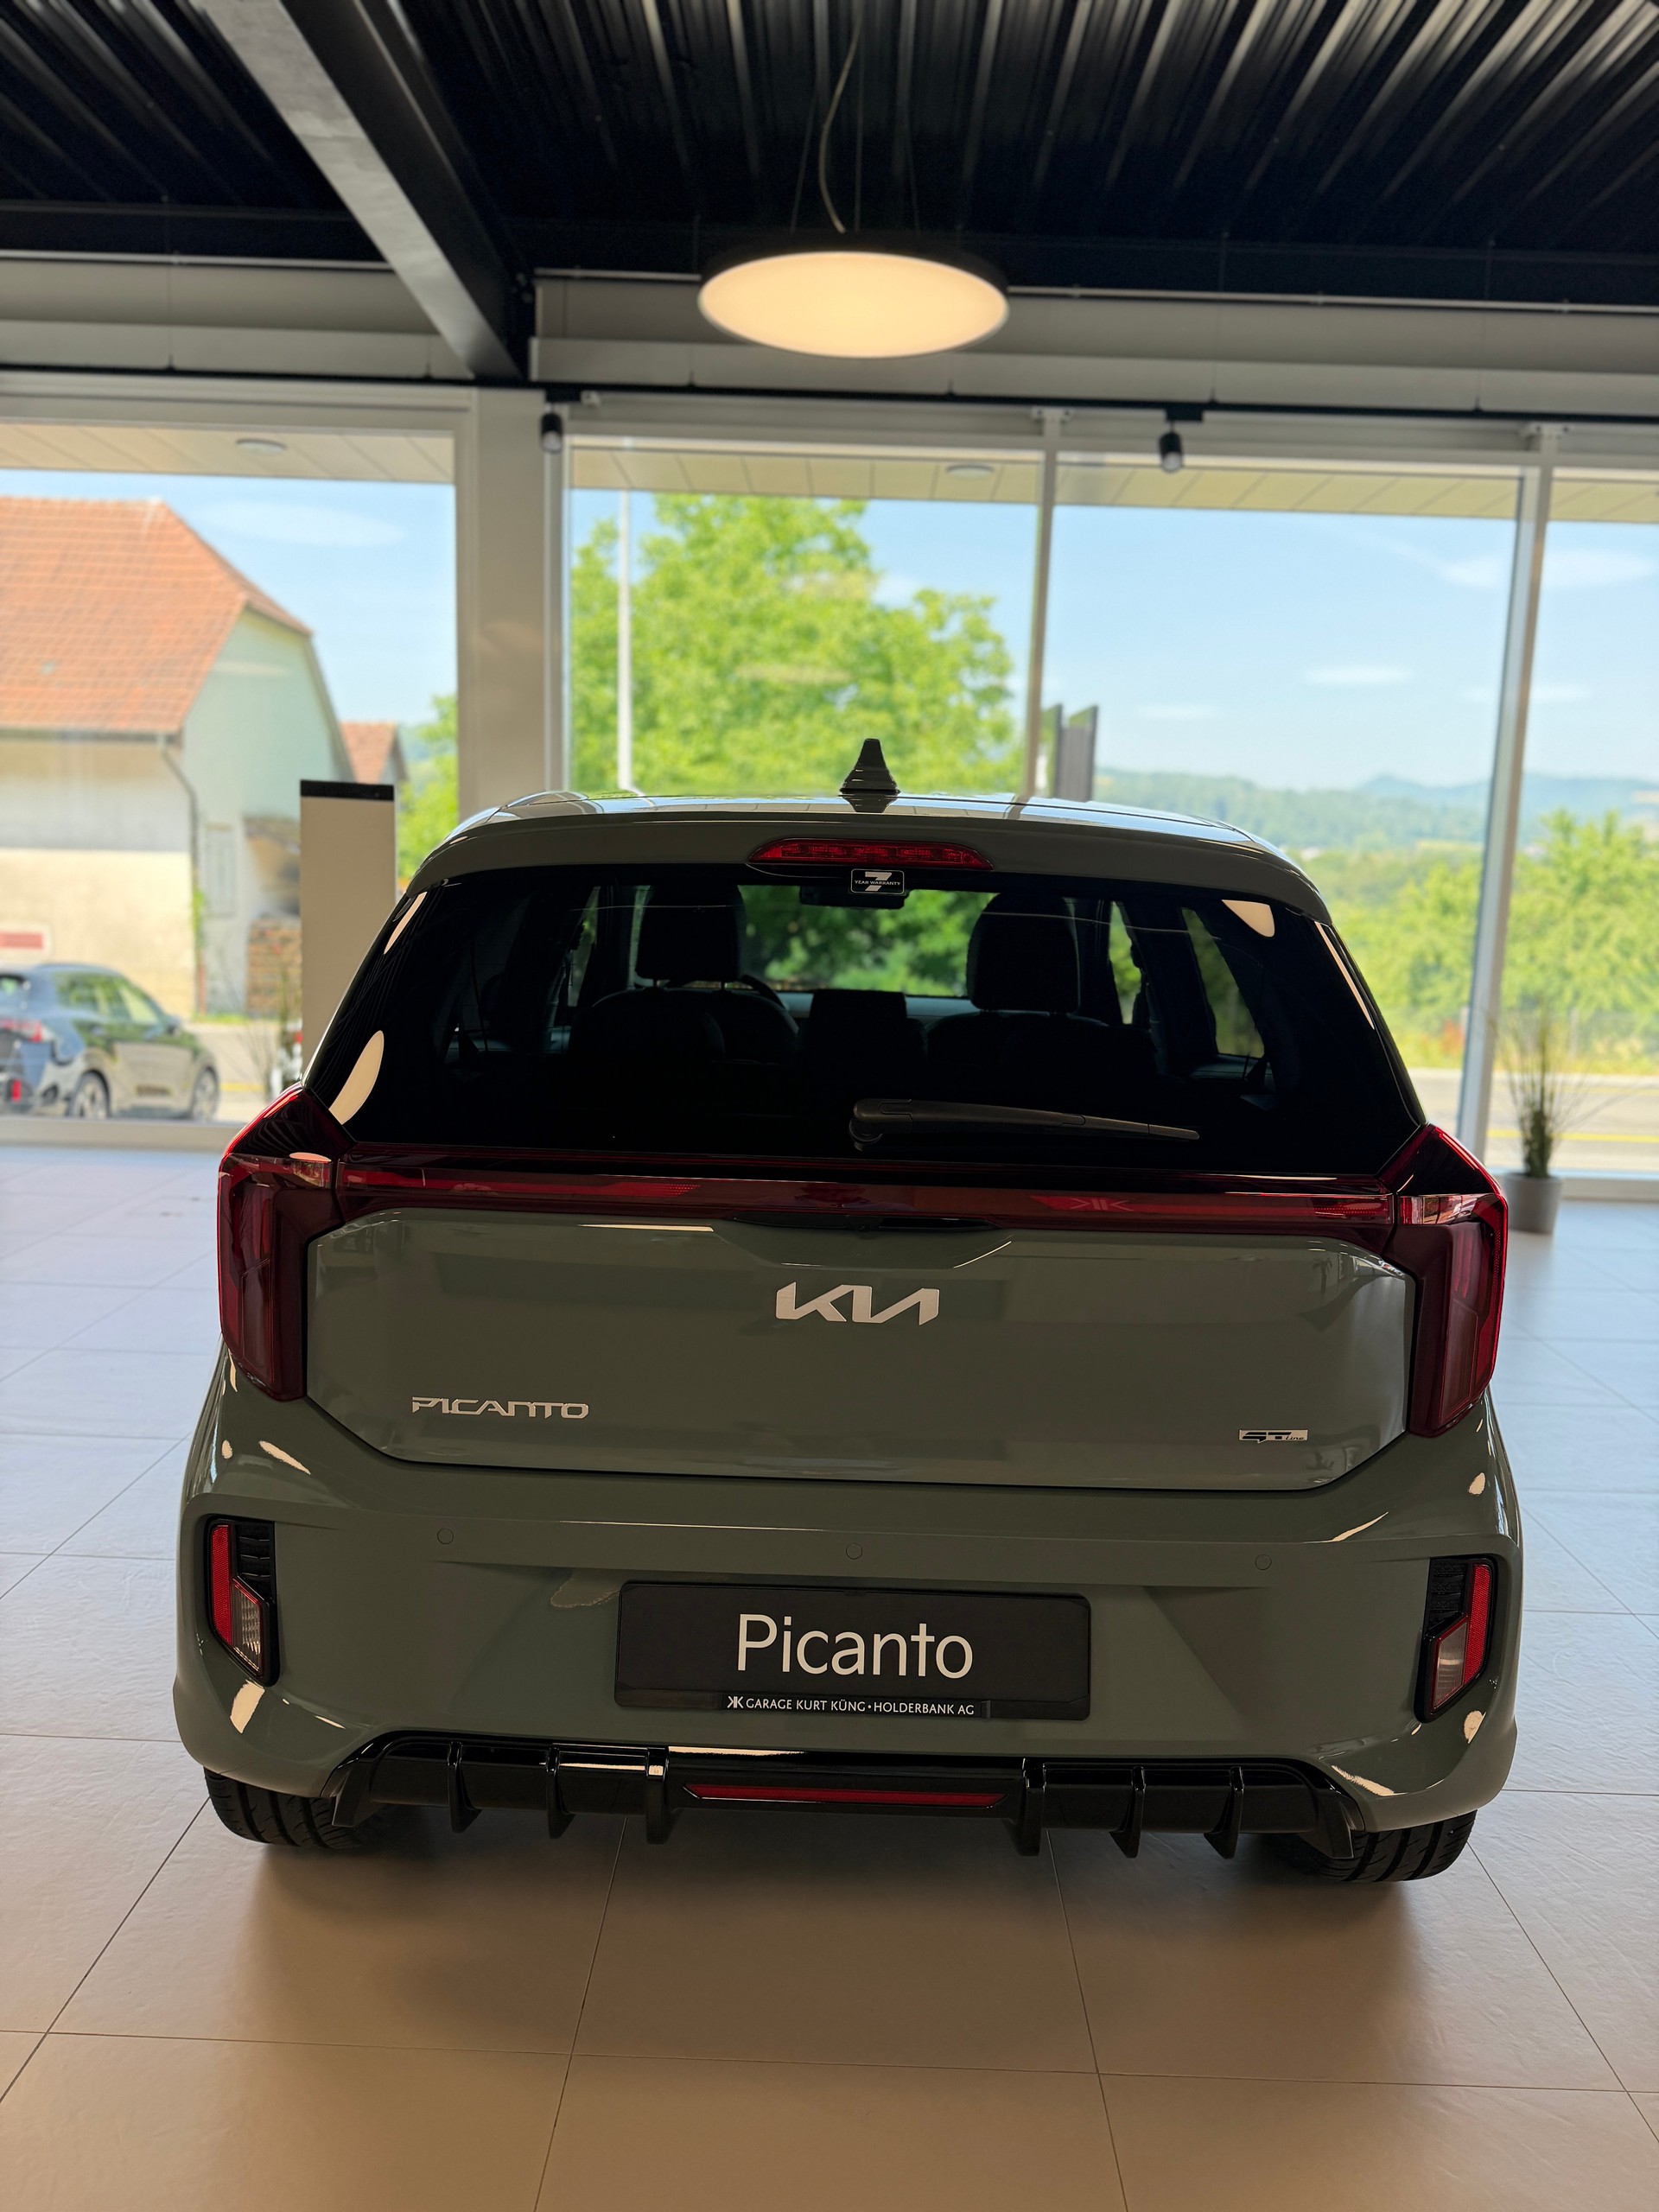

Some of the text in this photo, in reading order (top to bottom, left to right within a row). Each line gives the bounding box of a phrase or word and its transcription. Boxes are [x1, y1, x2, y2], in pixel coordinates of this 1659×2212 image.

[864, 871, 893, 892] 7
[776, 1281, 940, 1326] KIA
[412, 1396, 589, 1419] PICANTO
[1242, 1431, 1293, 1443] GT
[737, 1613, 973, 1679] Picanto
[746, 1698, 792, 1710] GARAGE
[796, 1700, 828, 1711] KURT
[830, 1699, 866, 1712] KÜNG
[873, 1701, 955, 1715] HOLDERBANK
[957, 1705, 975, 1715] AG
